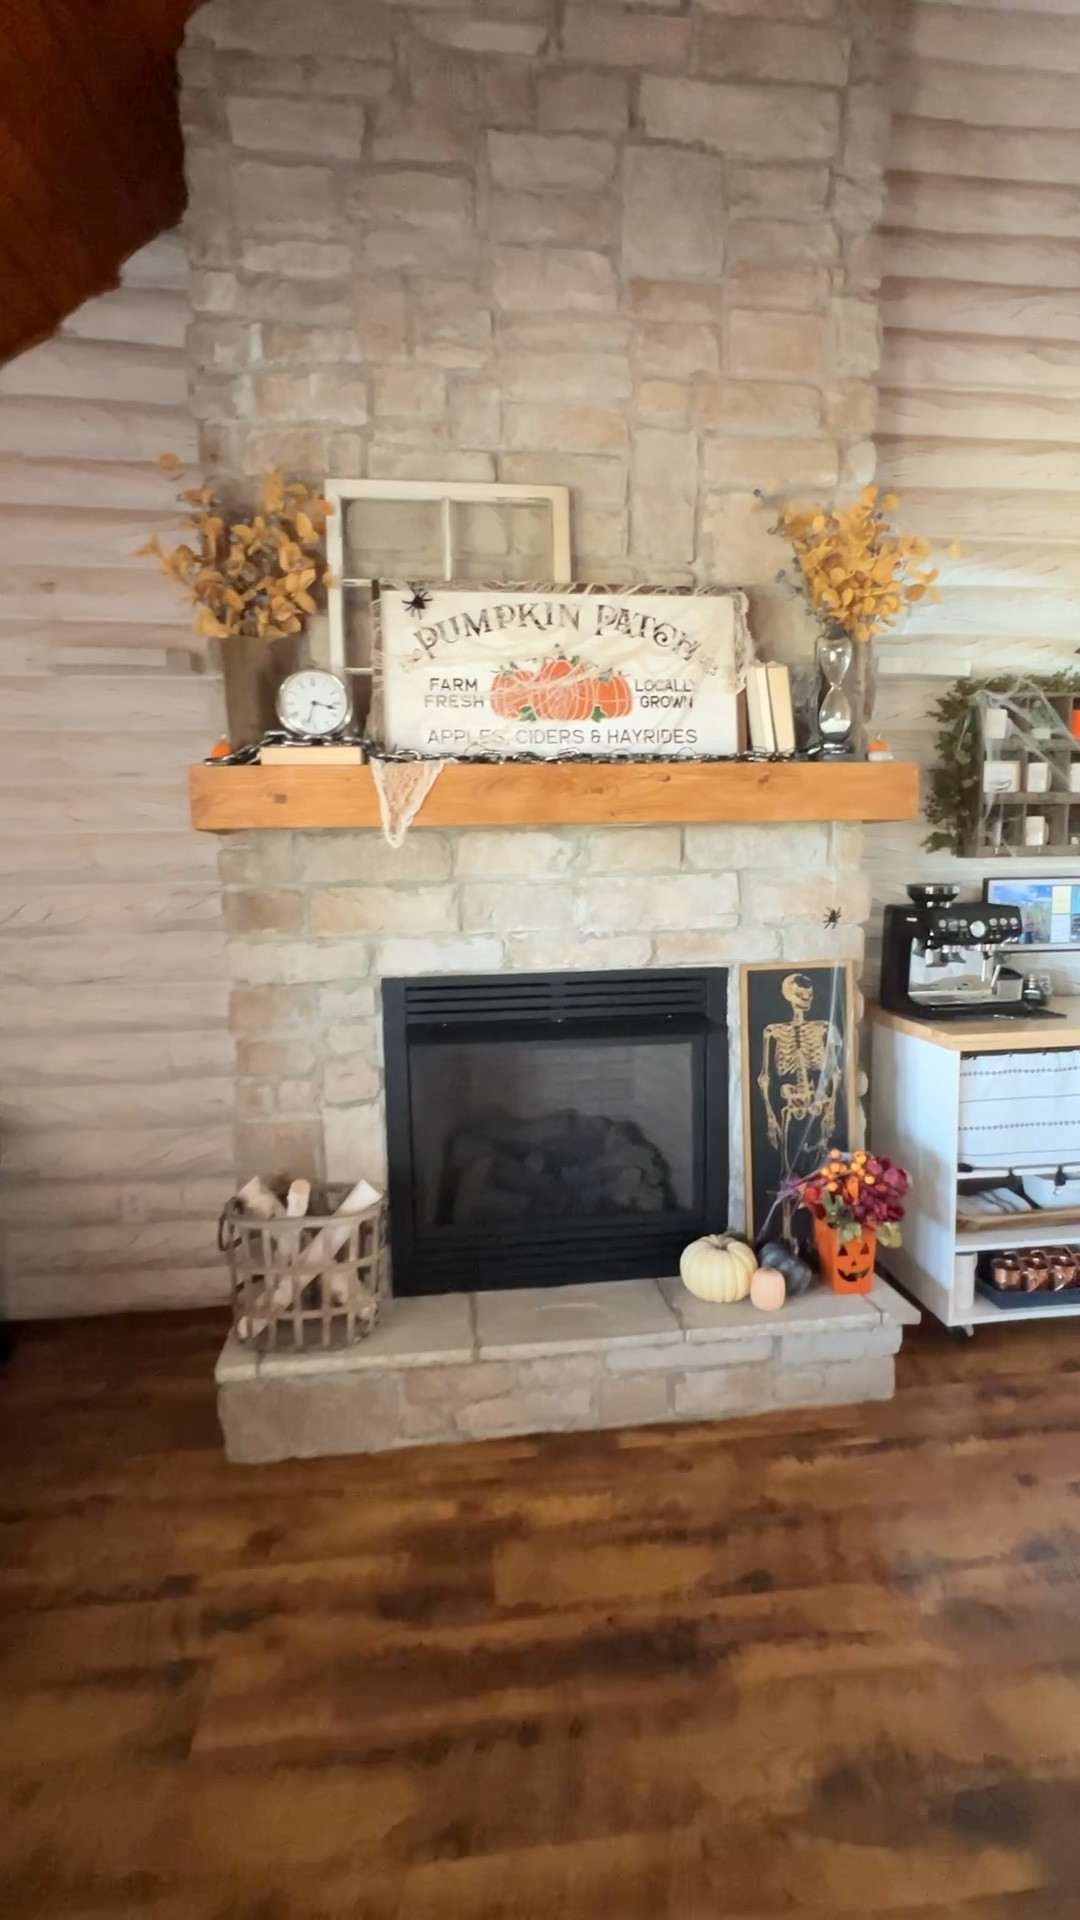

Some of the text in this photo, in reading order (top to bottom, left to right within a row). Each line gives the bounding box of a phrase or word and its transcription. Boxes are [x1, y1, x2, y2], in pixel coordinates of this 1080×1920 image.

[413, 602, 701, 661] PUMPKIN PATCH
[429, 678, 478, 691] FARM
[424, 695, 484, 708] FRESH
[515, 729, 585, 744] CIDERS
[591, 729, 601, 744] &
[608, 729, 698, 744] HAYRIDES
